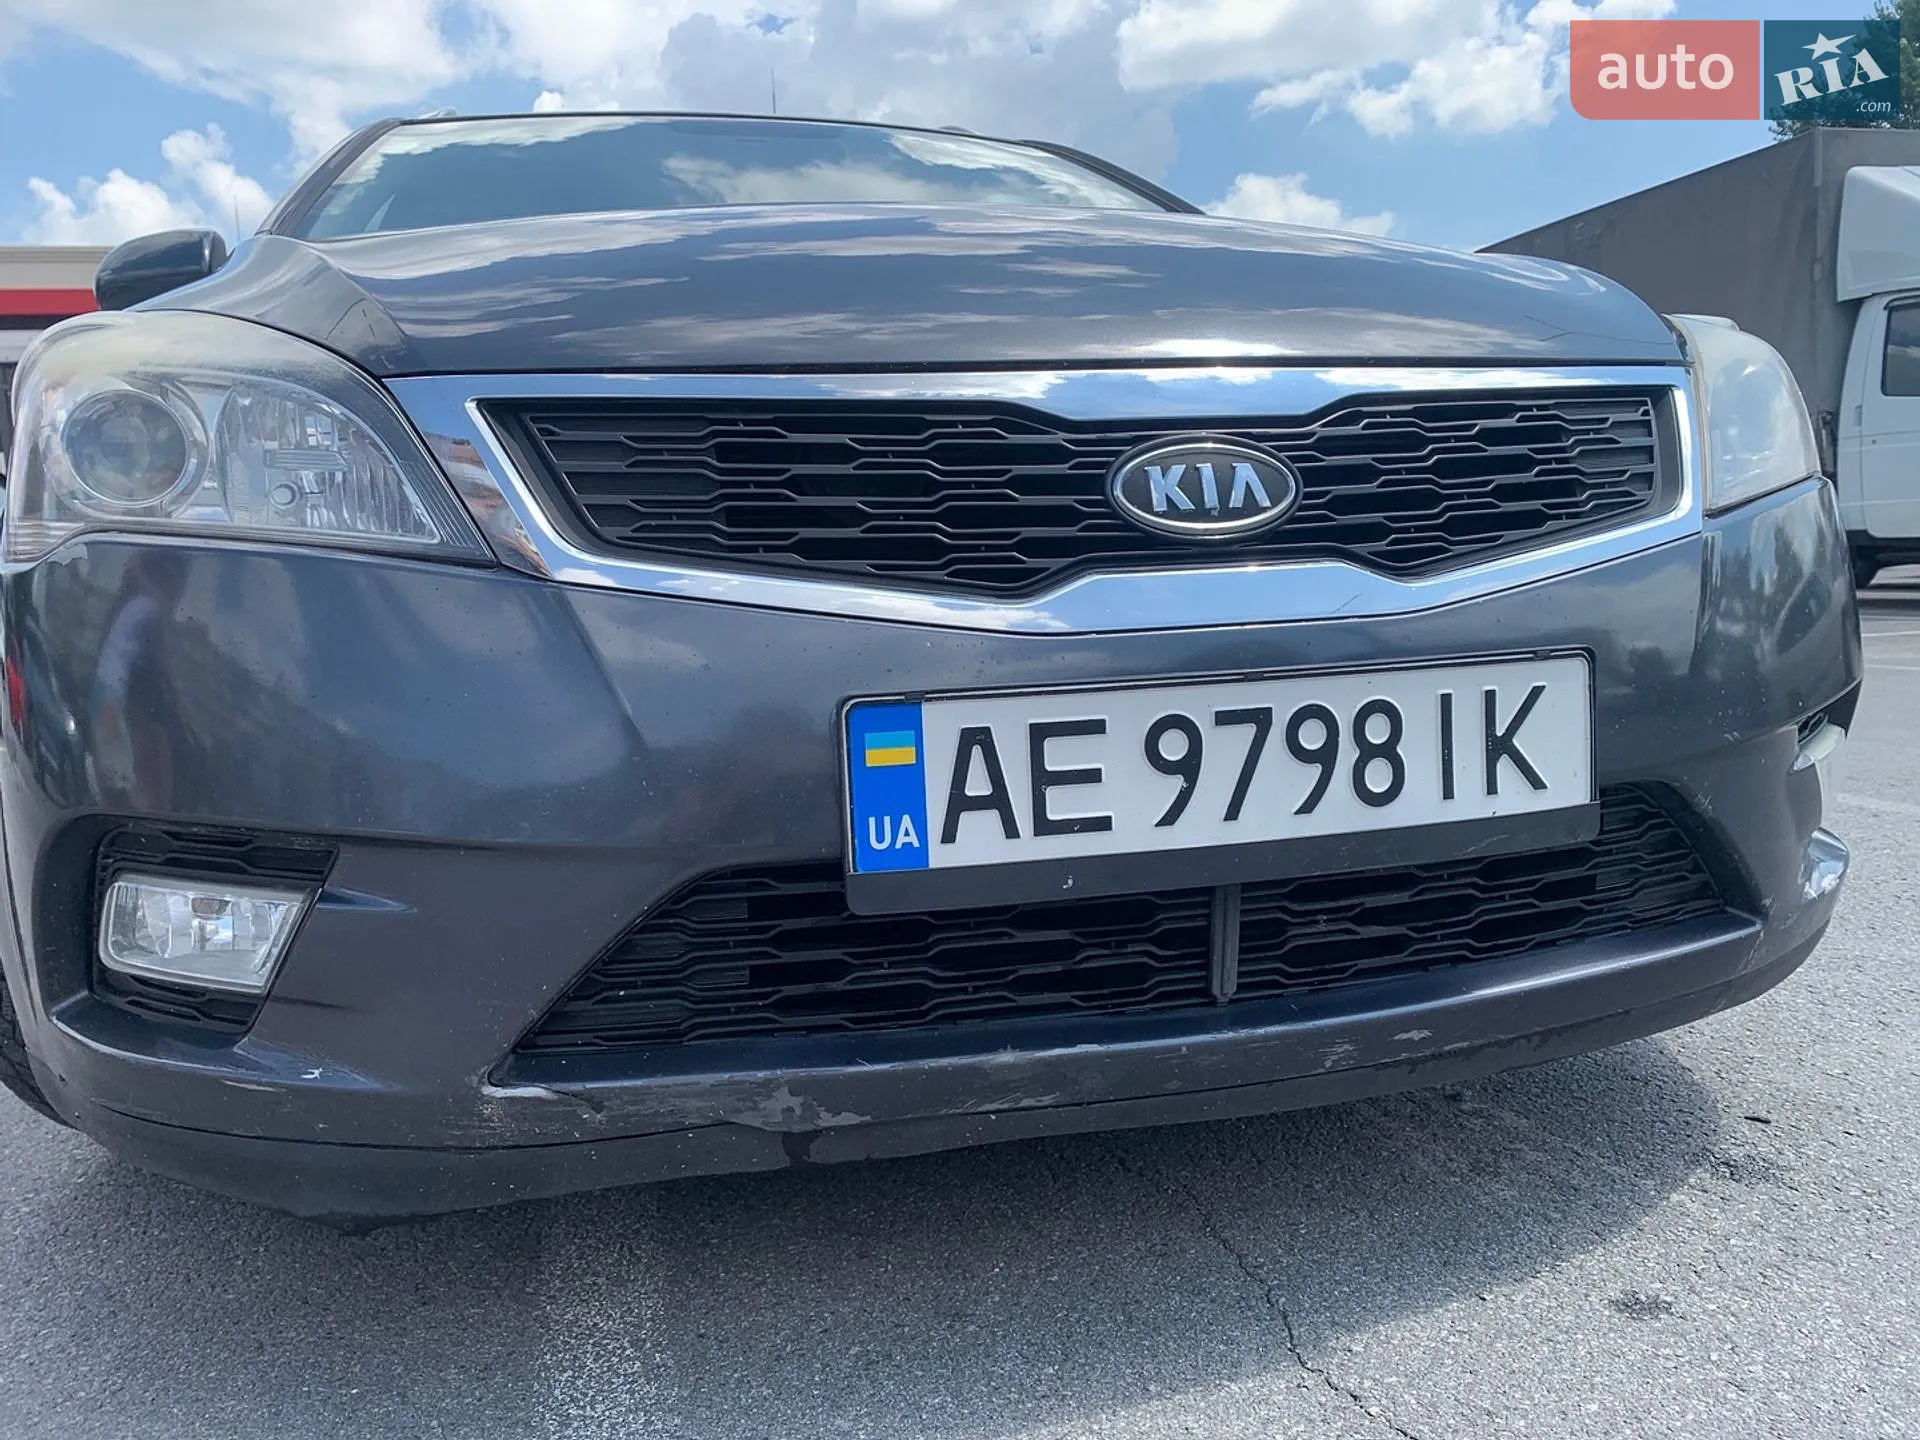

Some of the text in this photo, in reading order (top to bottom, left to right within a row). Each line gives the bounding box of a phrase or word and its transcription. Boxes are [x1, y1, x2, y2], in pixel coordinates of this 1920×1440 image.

[1144, 462, 1272, 512] KIA
[940, 684, 1549, 845] AE 9798 IK
[868, 815, 921, 851] UA
